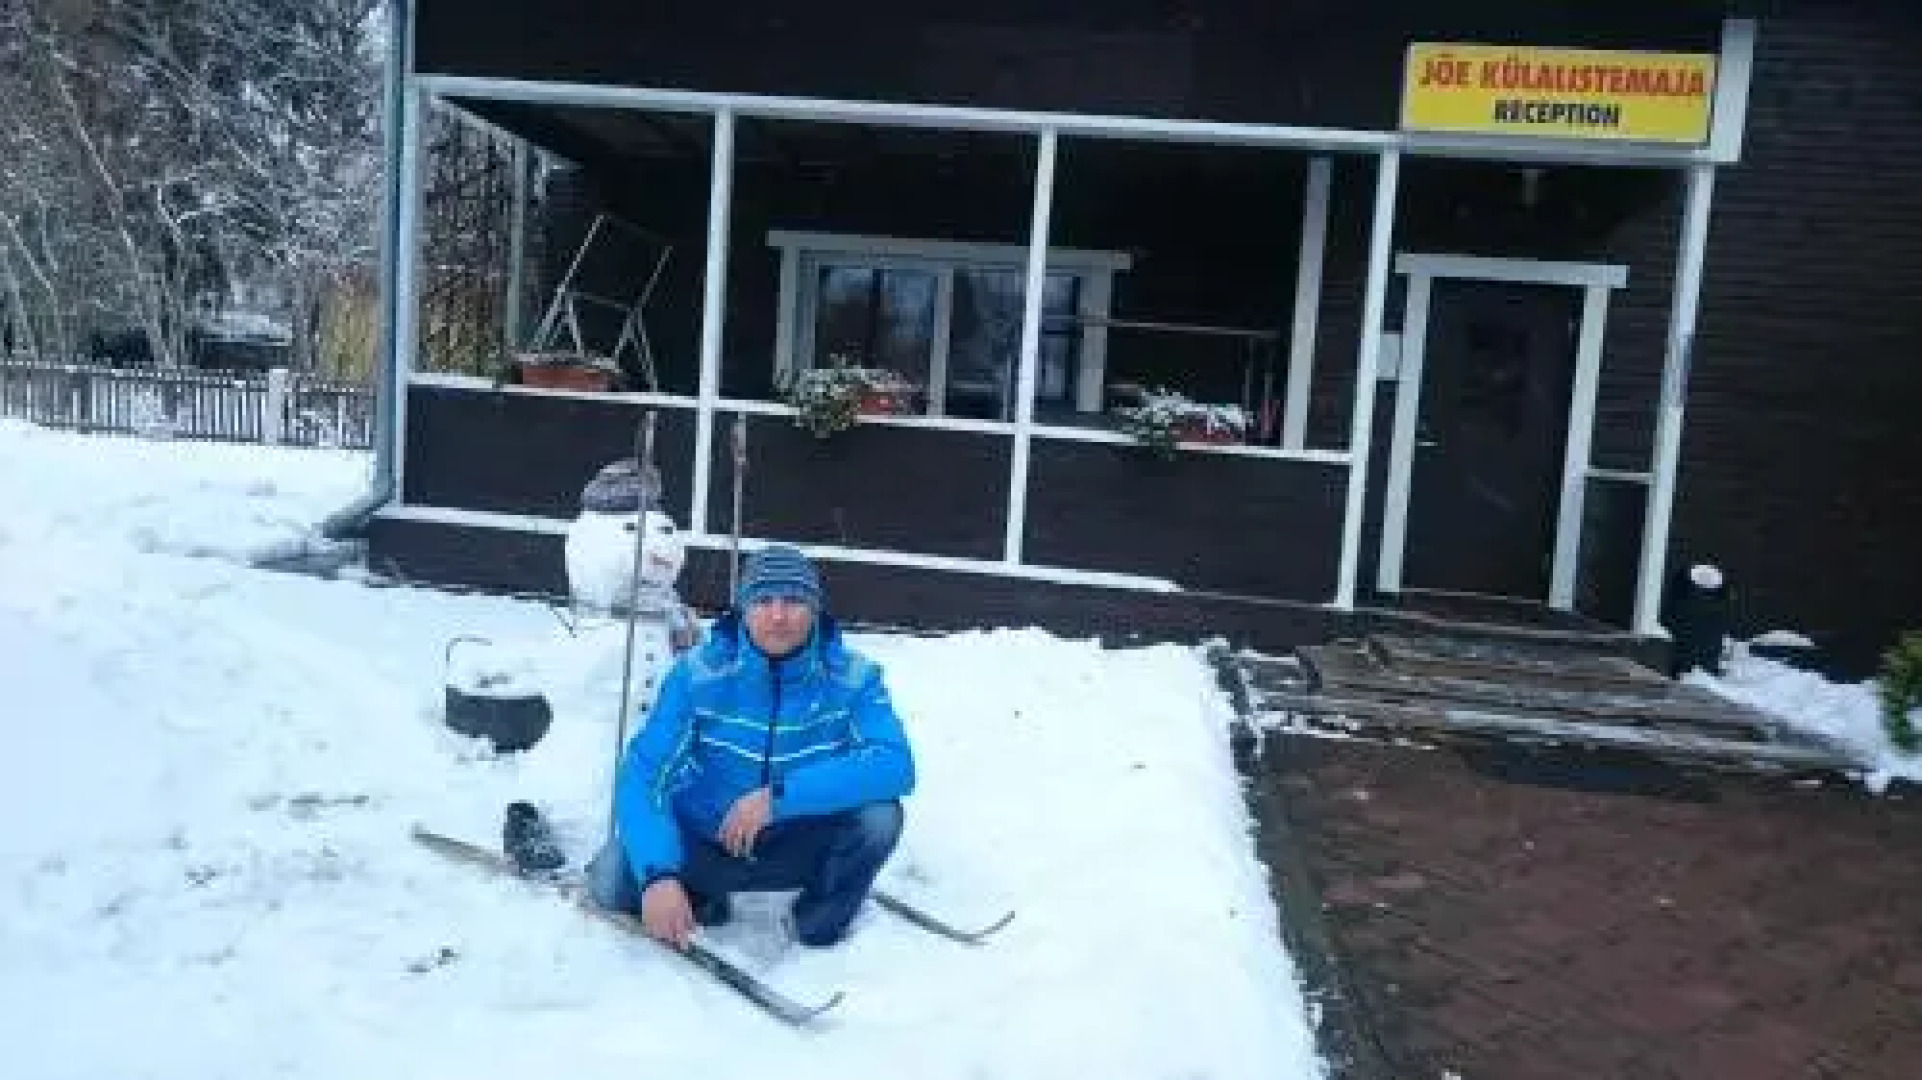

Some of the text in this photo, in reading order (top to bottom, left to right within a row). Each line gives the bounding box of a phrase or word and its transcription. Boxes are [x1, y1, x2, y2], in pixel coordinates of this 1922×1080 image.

[1418, 53, 1707, 97] JÕE KÜLALISTEMAJA
[1493, 99, 1620, 127] RECEPTION
